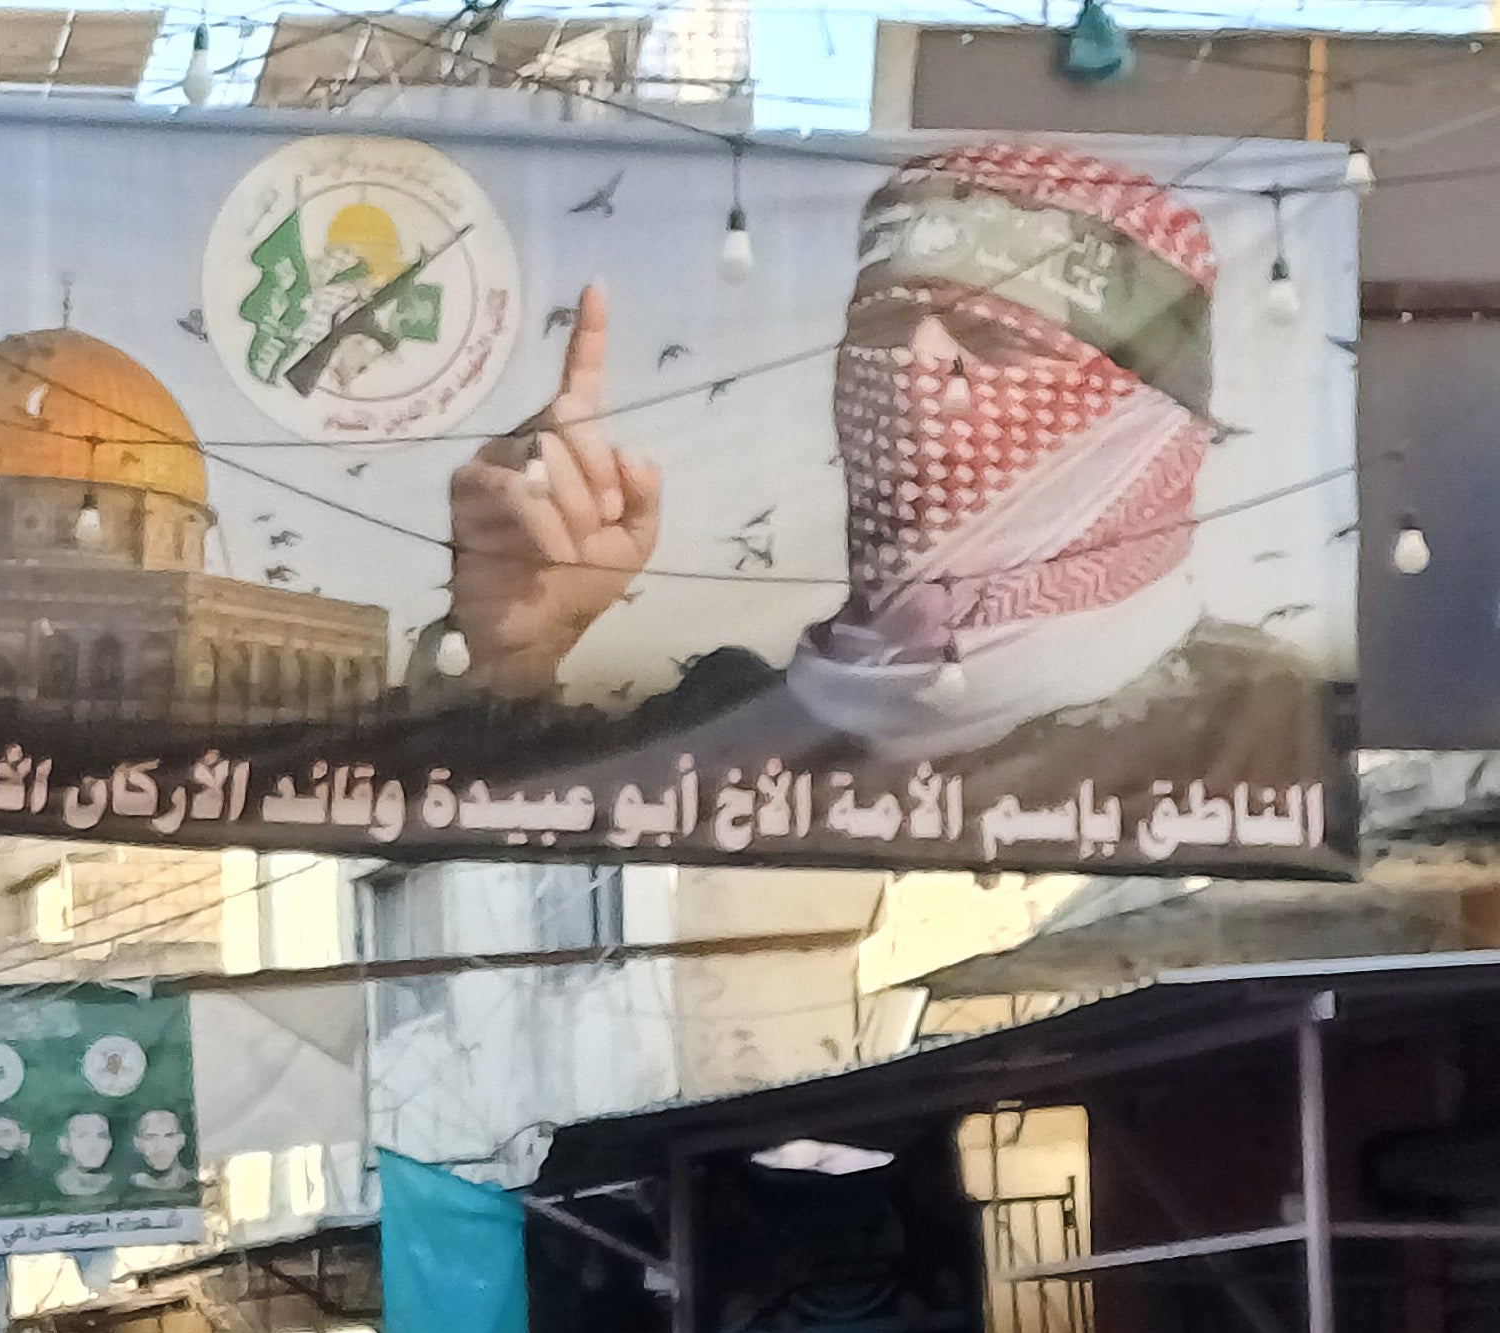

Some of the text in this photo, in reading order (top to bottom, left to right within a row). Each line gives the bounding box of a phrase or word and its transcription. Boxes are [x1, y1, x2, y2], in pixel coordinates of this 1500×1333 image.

[61, 747, 252, 838] الأركان
[260, 760, 406, 845] وقائد
[420, 765, 597, 848] عبيدة
[605, 750, 699, 850] أبو
[713, 755, 812, 854] الأخ
[1136, 776, 1325, 862] الناطق
